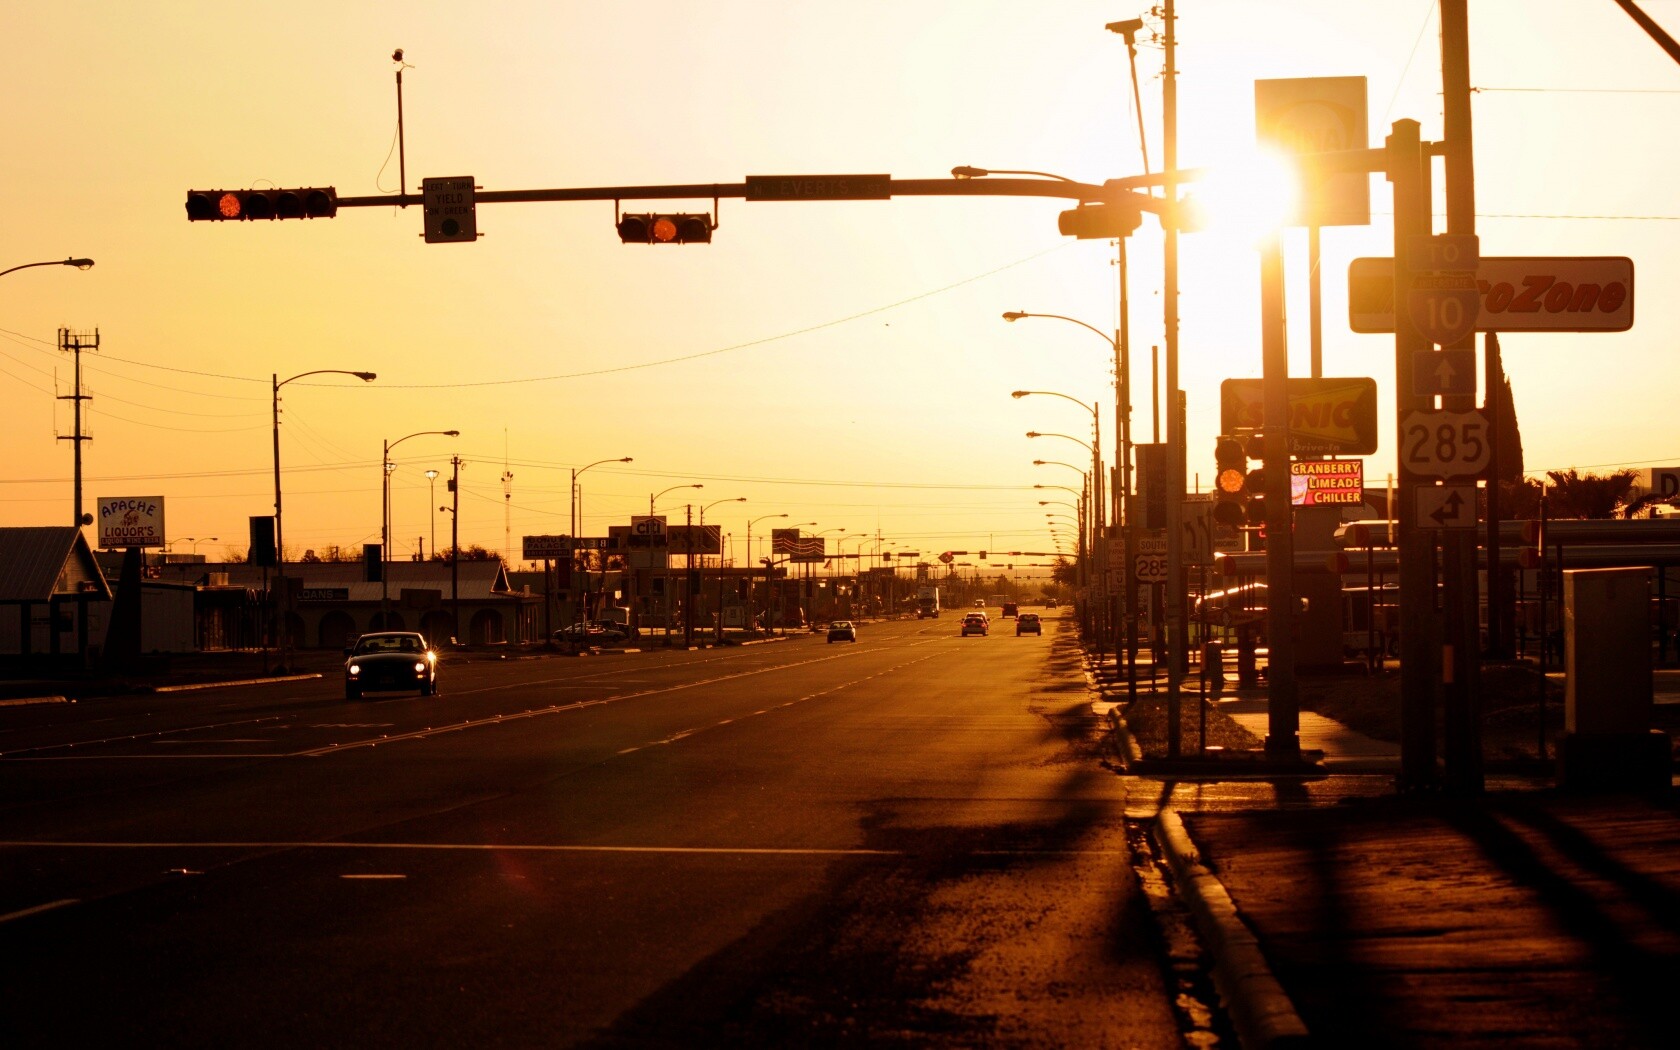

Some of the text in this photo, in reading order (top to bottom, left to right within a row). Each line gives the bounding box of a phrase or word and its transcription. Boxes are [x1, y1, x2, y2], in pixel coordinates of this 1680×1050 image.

[426, 182, 471, 191] LEFT TURN
[435, 193, 463, 204] YIELD
[445, 206, 468, 215] GREEN
[1425, 244, 1459, 262] TO
[1427, 297, 1463, 330] 10
[1408, 423, 1483, 464] 285
[1291, 463, 1359, 475] CRANBERRY
[1309, 477, 1360, 489] LIMEADE
[1314, 491, 1361, 503] CHILLER
[102, 500, 156, 518] APACHE
[105, 526, 154, 537] LIQUOR'S
[1140, 541, 1168, 550] SOUTH
[1138, 560, 1168, 577] 285
[296, 590, 334, 599] LOANS
